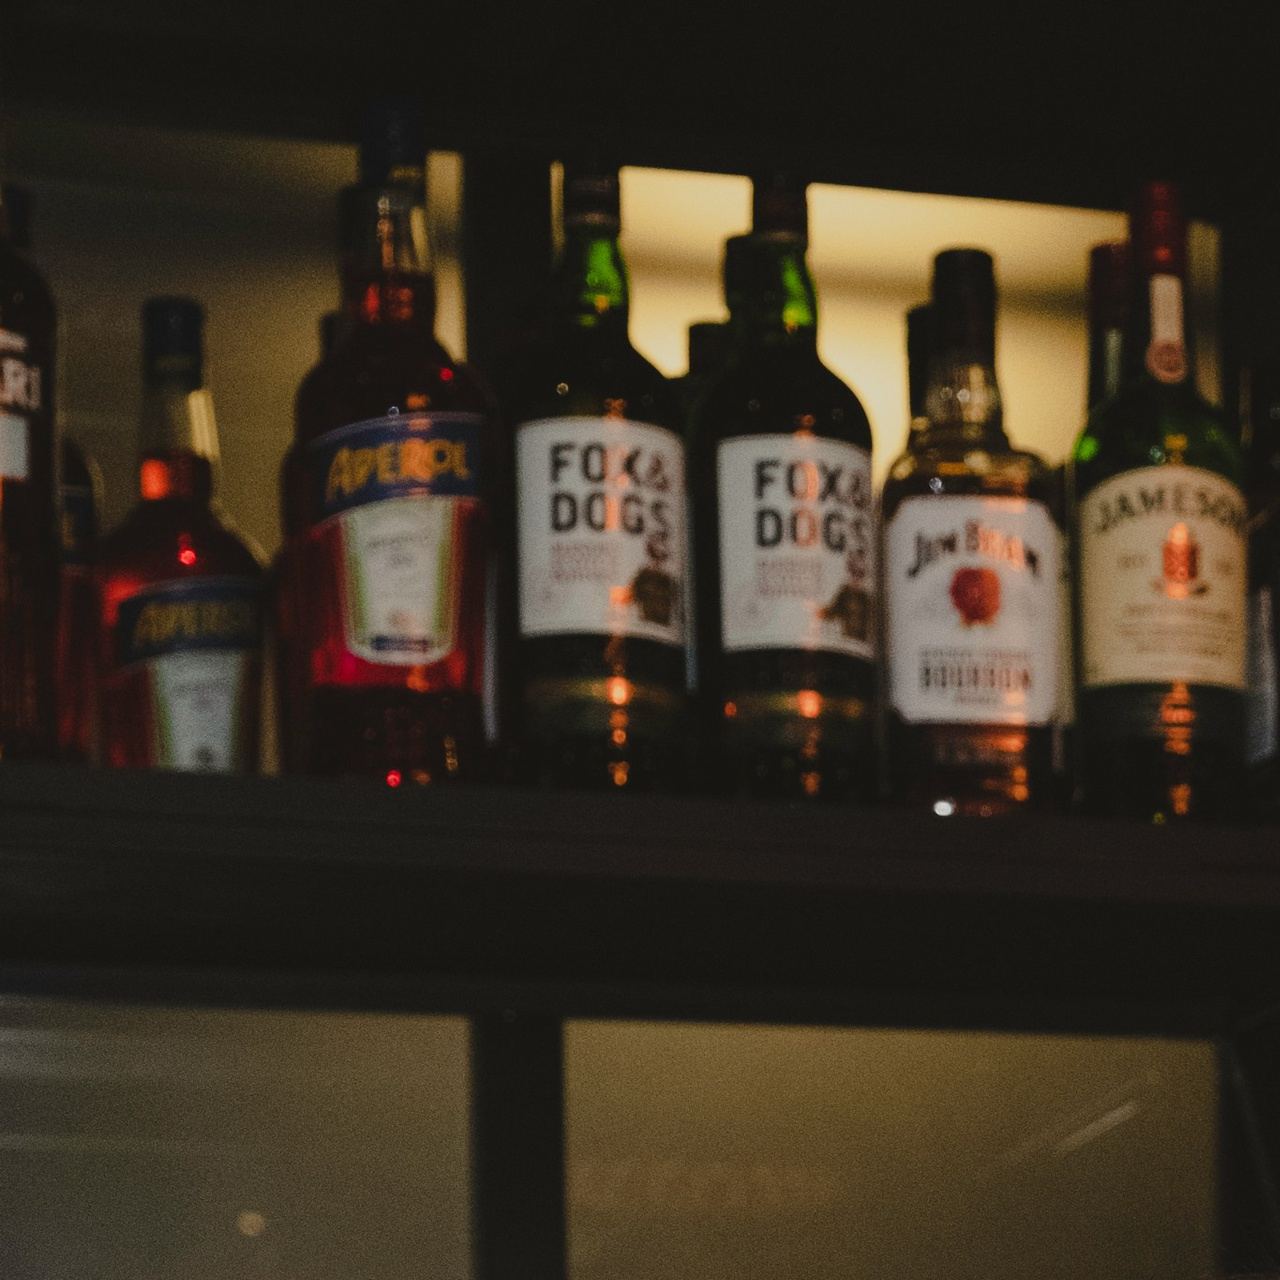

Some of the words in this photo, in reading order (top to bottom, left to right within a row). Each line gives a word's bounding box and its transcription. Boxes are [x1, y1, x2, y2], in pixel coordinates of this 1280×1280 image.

[323, 438, 472, 504] APEROL
[552, 493, 670, 538] DOGS
[755, 507, 870, 556] DOGS
